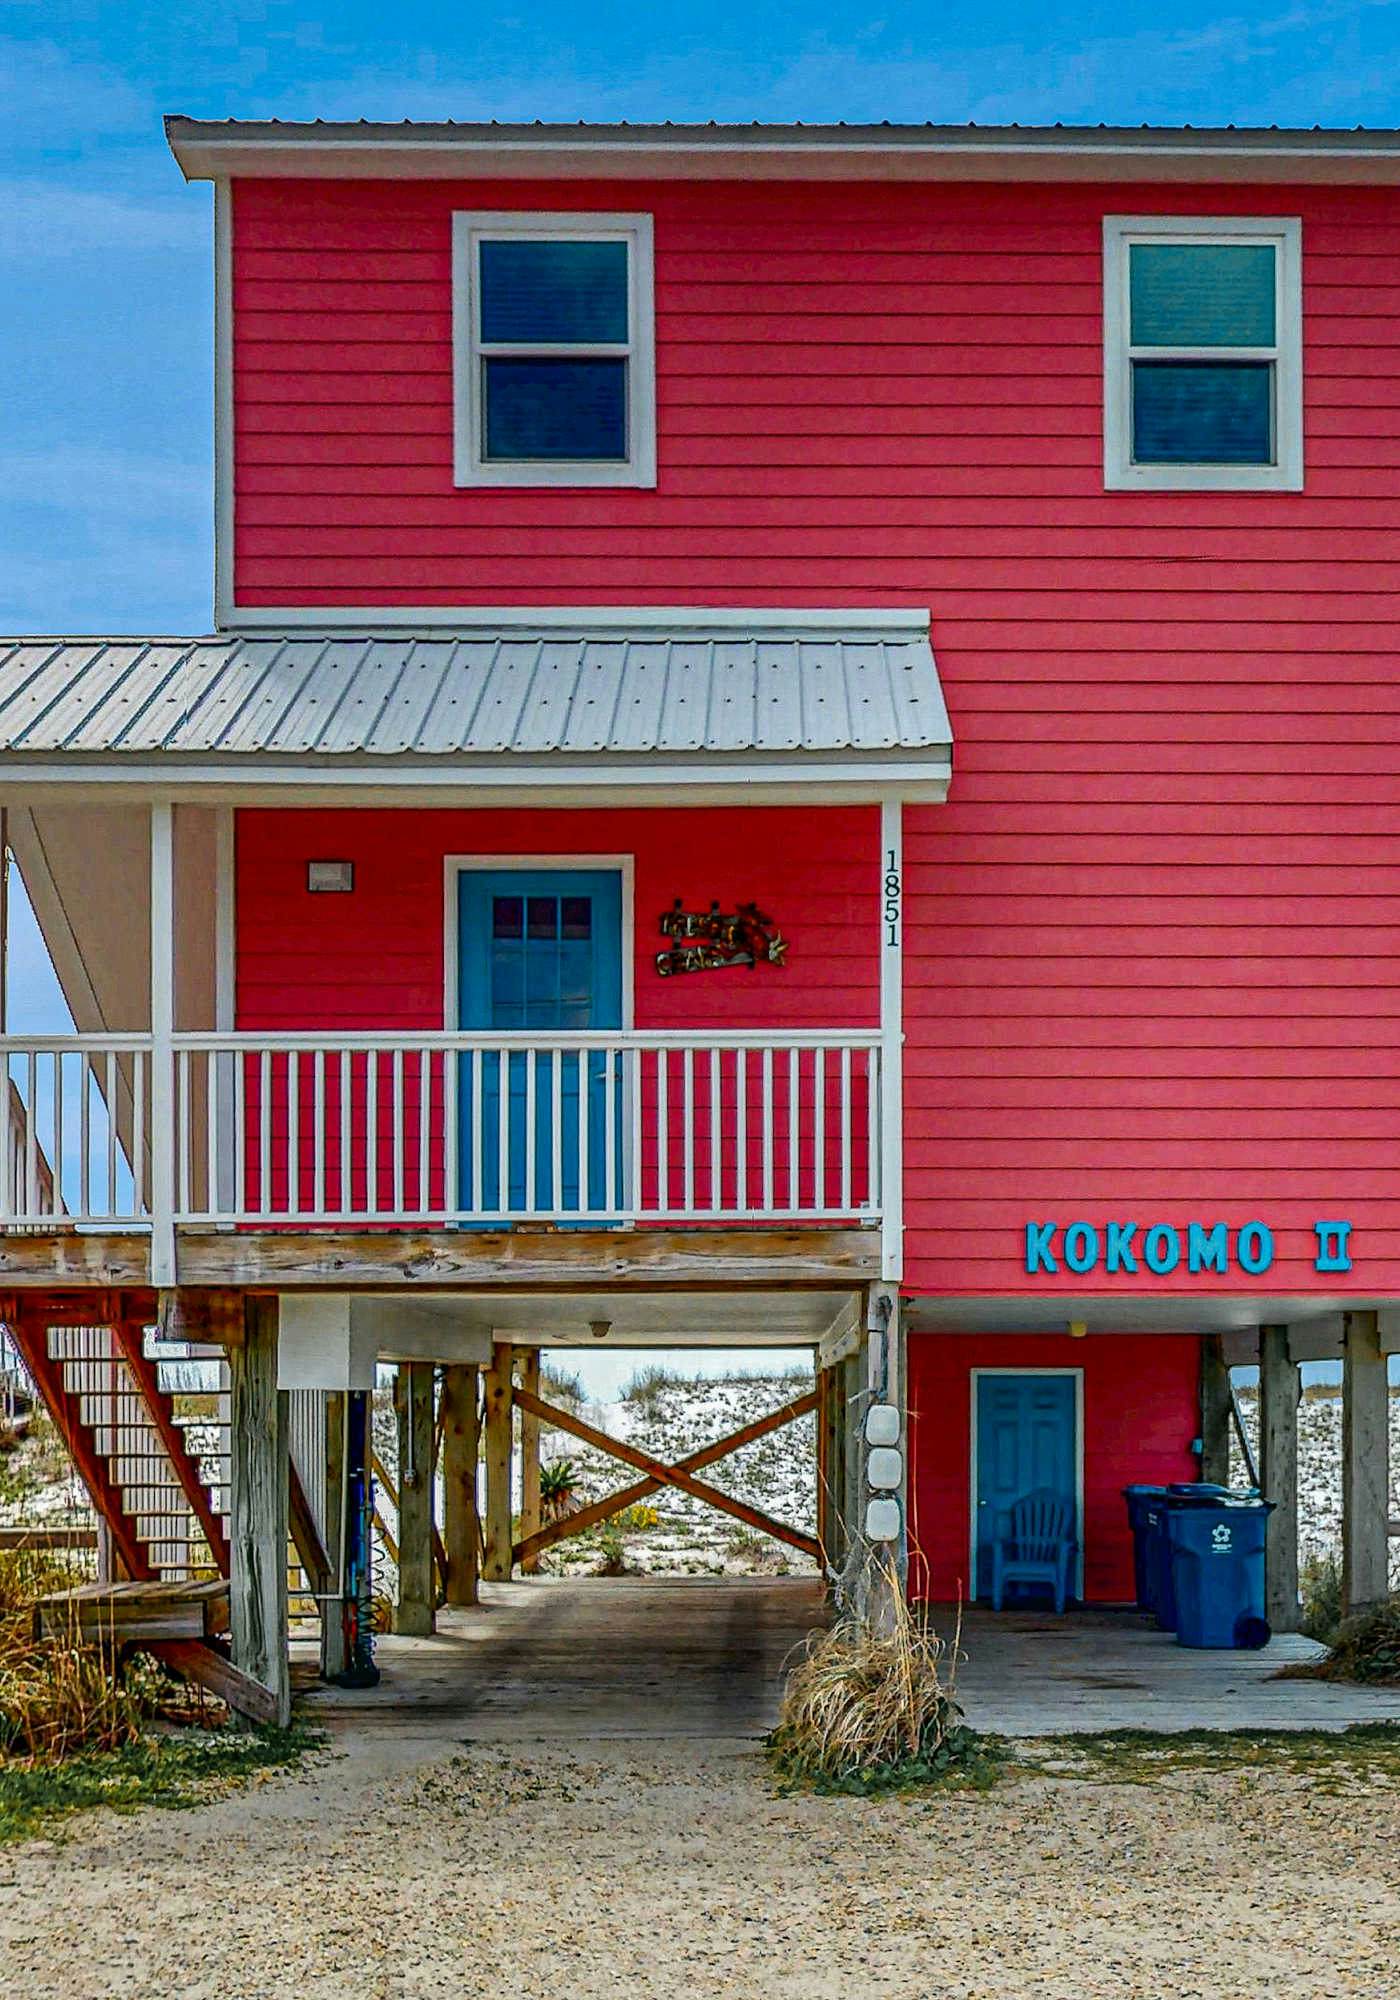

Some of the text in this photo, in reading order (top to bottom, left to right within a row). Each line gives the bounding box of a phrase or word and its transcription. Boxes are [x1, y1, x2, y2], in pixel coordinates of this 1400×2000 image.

[884, 850, 900, 947] 1851
[1025, 1220, 1352, 1274] KOKOMO II
